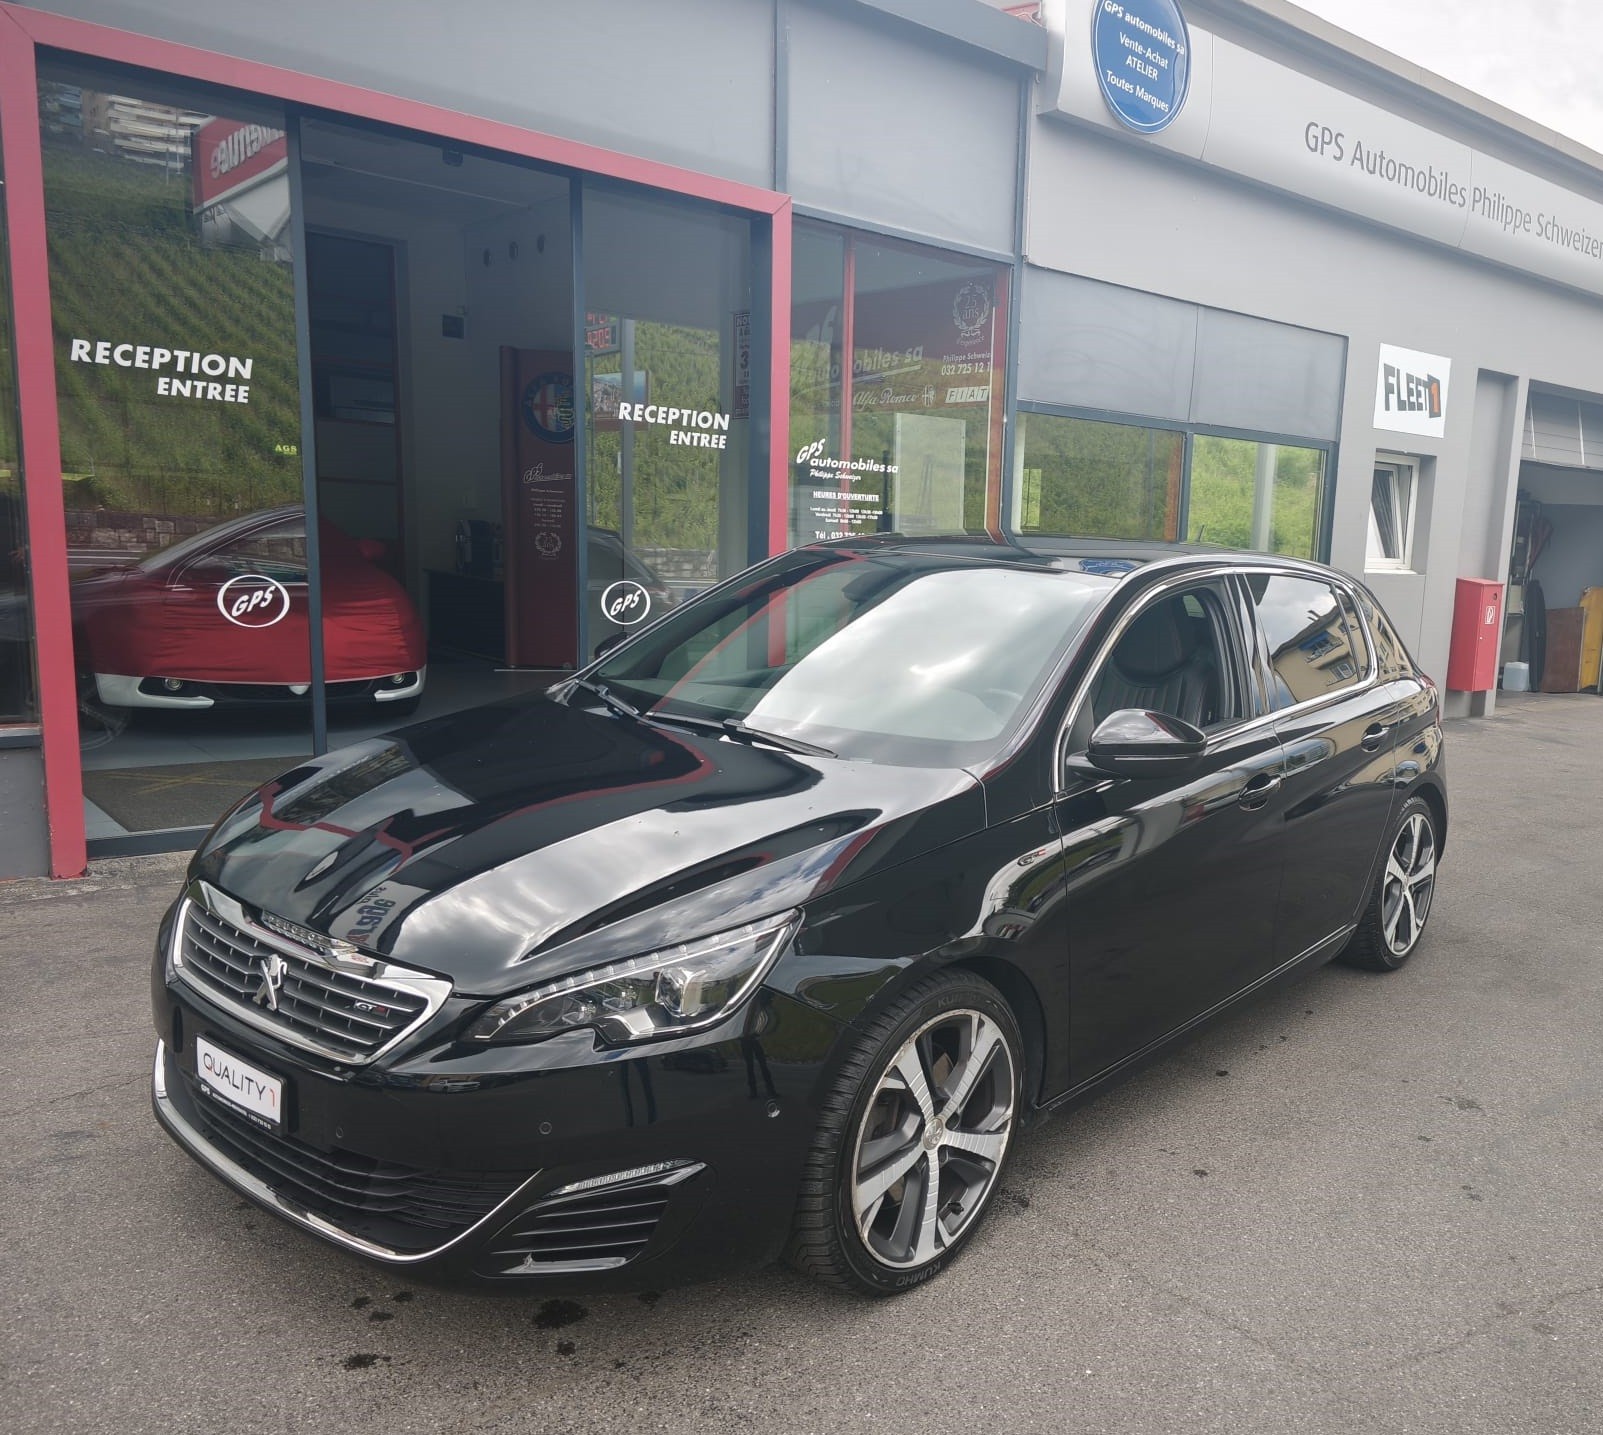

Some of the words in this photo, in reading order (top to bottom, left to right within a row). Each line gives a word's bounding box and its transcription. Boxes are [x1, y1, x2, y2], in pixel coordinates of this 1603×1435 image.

[1104, 1, 1124, 18] GPS
[1125, 12, 1176, 49] automobiles
[1176, 43, 1185, 55] sa
[1119, 31, 1168, 69] Vente-Achat
[1126, 55, 1158, 81] ATELIER
[1106, 70, 1134, 94] Toutes
[1135, 85, 1169, 113] Marques
[1305, 121, 1345, 162] GPS
[1350, 140, 1467, 208] Automobiles
[1471, 187, 1532, 235] Philippe
[1536, 213, 1603, 260] Schweizer
[71, 339, 253, 380] RECEPTION
[942, 364, 955, 376] 032
[957, 362, 972, 375] 725
[974, 361, 984, 373] 12
[157, 377, 250, 404] ENTREE
[946, 387, 989, 403] FIAT
[618, 402, 730, 431] RECEPTION
[669, 430, 727, 449] ENTREE
[796, 438, 826, 464] GPS
[809, 457, 885, 474] automobiles
[886, 464, 899, 474] sa
[813, 490, 837, 500] HEURES
[231, 585, 276, 617] GPS
[610, 589, 642, 616] GPS
